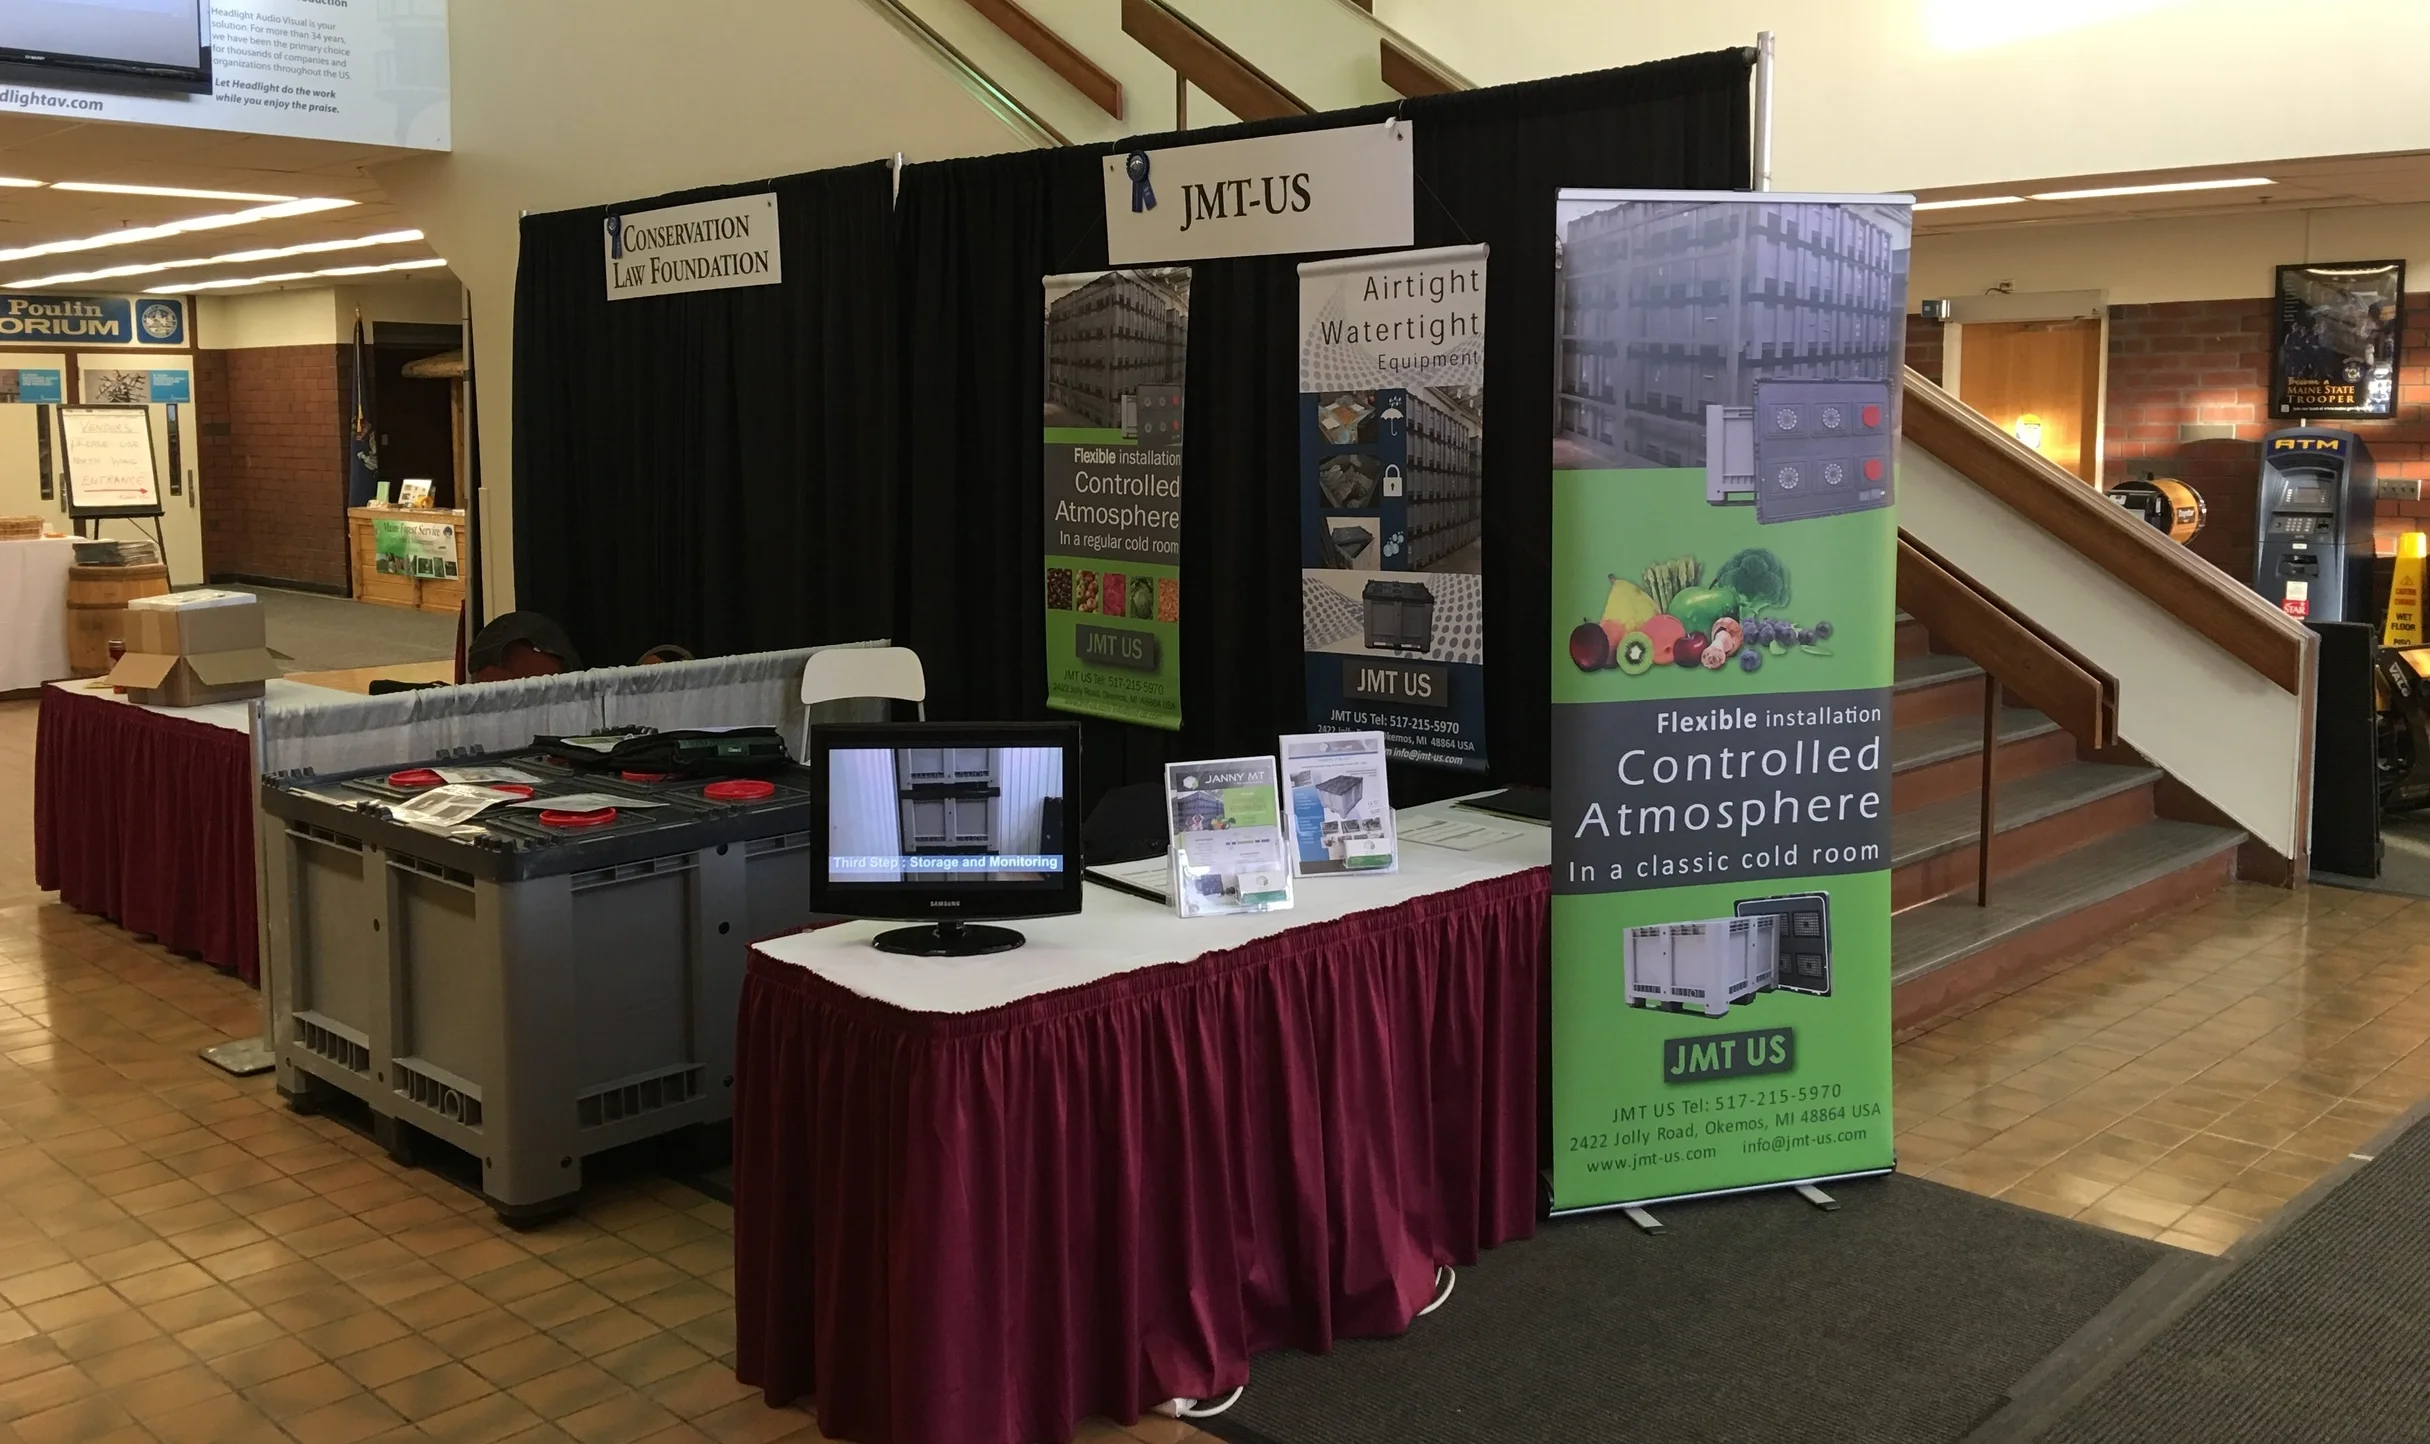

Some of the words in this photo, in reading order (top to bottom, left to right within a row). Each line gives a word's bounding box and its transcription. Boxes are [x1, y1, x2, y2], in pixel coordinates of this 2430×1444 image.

[212, 7, 254, 20] Headlight
[256, 12, 281, 23] Audio
[282, 16, 308, 27] Visual
[309, 20, 316, 28] is
[316, 23, 336, 31] your
[227, 33, 248, 43] have
[250, 36, 271, 46] been
[274, 39, 288, 48] the
[290, 42, 322, 54] primary
[324, 46, 350, 56] choice
[250, 25, 264, 33] For
[266, 28, 288, 37] more
[290, 30, 309, 39] than
[312, 32, 321, 40] 34
[324, 35, 346, 45] years,
[212, 44, 225, 52] for
[227, 46, 272, 59] thousands
[274, 51, 282, 60] of
[284, 54, 329, 66] companies
[330, 58, 346, 68] and
[213, 58, 272, 70] organizations
[273, 64, 322, 77] throughout
[323, 69, 338, 78] the
[215, 78, 230, 88] Let
[232, 80, 280, 94] Headlight
[282, 85, 294, 94] do
[296, 86, 310, 96] the
[312, 90, 336, 98] work
[216, 93, 242, 103] while
[244, 98, 262, 106] you
[264, 99, 290, 110] enjoy
[292, 100, 307, 110] the
[308, 104, 340, 114] praise.
[1180, 172, 1311, 232] JMT-US
[613, 262, 646, 289] LAW
[1363, 269, 1479, 304] Airtight
[8, 299, 103, 317] Poulin
[0, 318, 119, 336] ORIUM
[1321, 312, 1478, 346] Watertight
[1378, 351, 1478, 374] Equipment
[2287, 394, 2354, 404] TROOPER
[2324, 385, 2354, 394] STATE
[2274, 439, 2339, 450] ATM
[1074, 448, 1116, 464] Flexible
[1120, 449, 1181, 466] installation
[81, 475, 146, 486] ENTRANCE
[1075, 470, 1180, 498] Controlled
[1054, 500, 1180, 530] Atmosphere
[419, 524, 440, 536] Service
[1060, 530, 1070, 545] In
[1073, 534, 1080, 546] a
[1083, 534, 1122, 552] regular
[1124, 536, 1149, 552] cold
[1152, 540, 1180, 554] room
[2284, 604, 2306, 614] STAR
[2396, 612, 2412, 621] WET
[2391, 622, 2416, 631] FLOOR
[1086, 632, 1117, 656] JMT
[1122, 637, 1142, 660] US
[1064, 670, 1080, 681] JMT
[1081, 672, 1092, 684] US
[1108, 676, 1164, 696] 517-215-5970
[1357, 668, 1398, 694] JMT
[1404, 672, 1432, 698] US
[1330, 709, 1352, 722] JMT
[1354, 712, 1368, 724] US
[1370, 714, 1388, 726] Tel:
[1390, 715, 1460, 734] 517-215-5970
[1658, 707, 1758, 734] Flexible
[1766, 706, 1882, 728] installation
[1393, 747, 1464, 765] info@jmt-us.com
[1457, 740, 1476, 752] USA
[1618, 736, 1880, 786] Controlled
[1205, 772, 1244, 784] JANNY
[1247, 772, 1265, 780] MT
[1574, 790, 1880, 838] Atmosphere
[833, 856, 866, 869] Third
[870, 856, 898, 871] Step
[910, 856, 959, 871] Storage
[962, 856, 986, 868] and
[989, 855, 1058, 869] Monitoring
[1569, 861, 1595, 883] In
[1610, 862, 1622, 880] a
[1636, 851, 1729, 878] classic
[1742, 844, 1798, 870] cold
[1812, 842, 1879, 865] room
[1670, 1039, 1736, 1076] JMT
[1747, 1034, 1786, 1068] US
[1612, 1104, 1649, 1124] JMT
[1653, 1102, 1676, 1119] US
[1681, 1098, 1710, 1116] Tel:
[1715, 1084, 1842, 1112] 517-215-5970
[1570, 1134, 1608, 1152] 2422
[1614, 1128, 1650, 1149] Jolly
[1657, 1124, 1698, 1142] Road,
[1705, 1116, 1768, 1136] Okemos,
[1775, 1112, 1795, 1128] MI
[1800, 1106, 1846, 1125] 48864
[1852, 1102, 1882, 1120] USA
[1586, 1146, 1717, 1174] www.jmt-us.com
[1743, 1128, 1867, 1155] info@jmt-us.com
